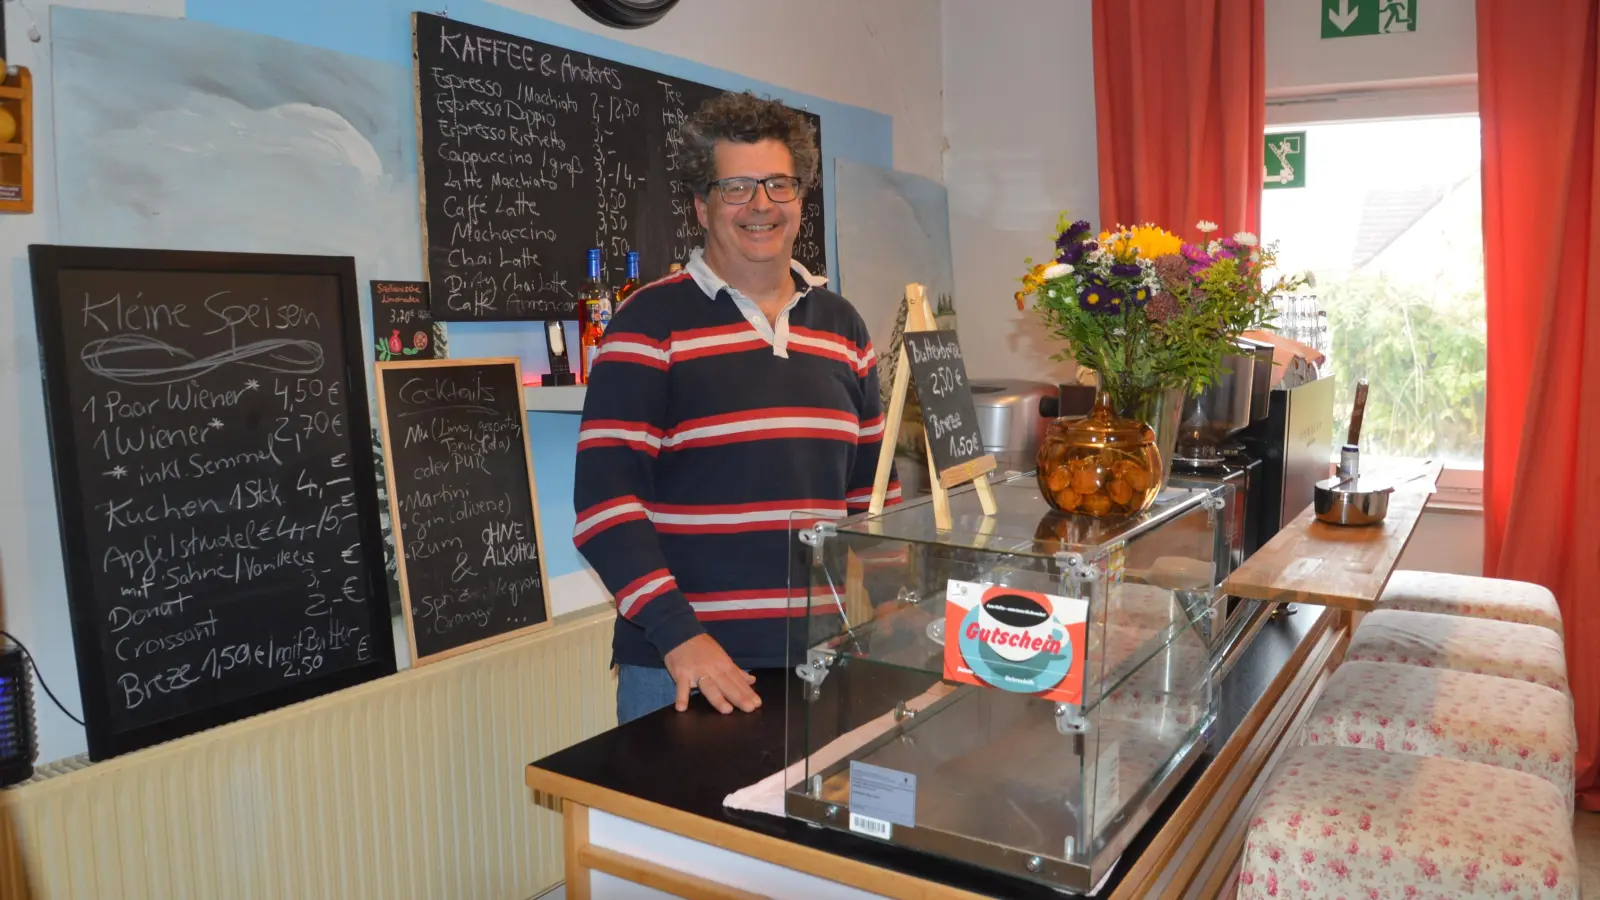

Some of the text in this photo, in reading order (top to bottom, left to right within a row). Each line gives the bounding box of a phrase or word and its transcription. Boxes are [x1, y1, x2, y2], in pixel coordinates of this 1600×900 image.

[440, 25, 621, 90] KAFFEE & Anderes
[432, 66, 502, 99] Espresso
[657, 80, 684, 105] Tee
[436, 92, 502, 126] Espresso
[504, 100, 556, 136] Doppio
[438, 119, 506, 148] Espresso
[509, 125, 566, 151] Ristretto
[665, 128, 684, 156] Affo
[438, 142, 533, 180] Cappuccino
[444, 169, 484, 191] Latte
[491, 169, 558, 191] Macchiato
[495, 191, 540, 216] Latte
[671, 199, 692, 223] Saft
[448, 248, 492, 268] Chai
[499, 247, 542, 268] Latte
[444, 271, 574, 303] Dirty Chai Latte
[203, 291, 320, 358] Speisen
[398, 371, 496, 405] Cocktails
[105, 391, 160, 423] Paar
[929, 411, 962, 440] Breze
[188, 433, 283, 478] Semmel
[413, 456, 449, 480] oder
[95, 493, 224, 532] Kuchen
[405, 483, 469, 512] Martini
[411, 512, 445, 540] Gin
[481, 521, 525, 546] OHNE
[103, 519, 259, 580] Apfelstrudel
[408, 536, 463, 561] Rum
[451, 543, 537, 583] & ALKOHOL
[120, 575, 155, 599] mit
[115, 608, 219, 662] Croissant
[965, 621, 1061, 655] Gutschein
[282, 654, 323, 678] 2,50
[117, 663, 201, 710] Breze
